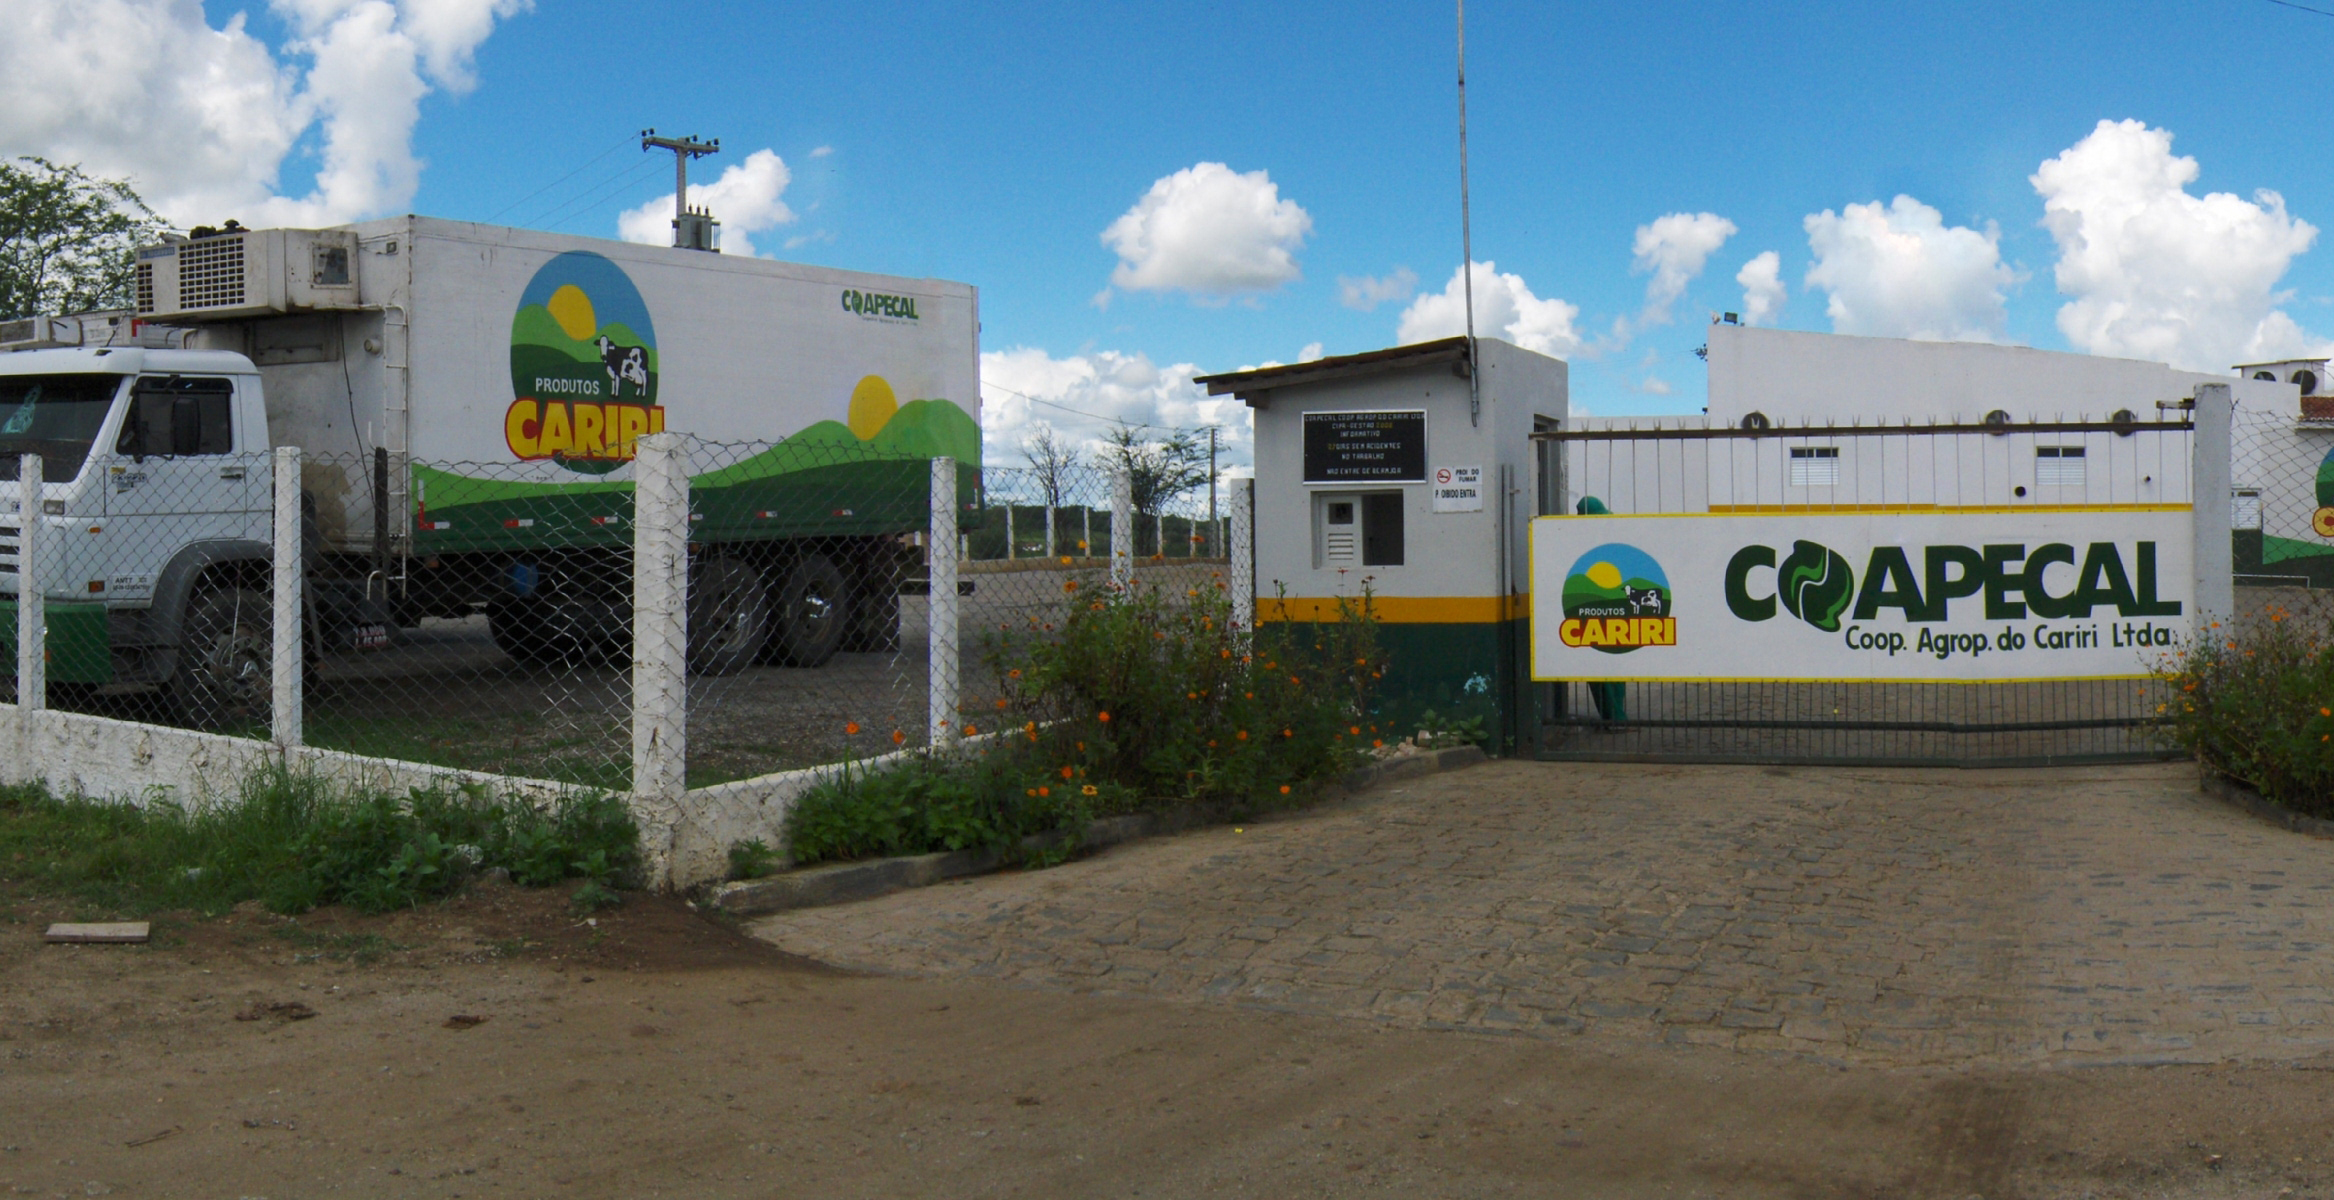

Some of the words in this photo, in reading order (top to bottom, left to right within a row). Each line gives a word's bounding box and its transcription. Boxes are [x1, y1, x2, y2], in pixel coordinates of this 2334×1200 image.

[841, 289, 919, 320] COAPECAL
[535, 377, 600, 395] PRODUTOS
[1725, 540, 2182, 632] COAPECAL
[1578, 607, 1626, 616] PRODUTOS
[1559, 616, 1677, 648] CARIRI
[1845, 625, 1908, 656] Coop.
[1916, 627, 1992, 660] Agrop.
[1997, 626, 2026, 651] do
[2033, 624, 2098, 649] Cariri
